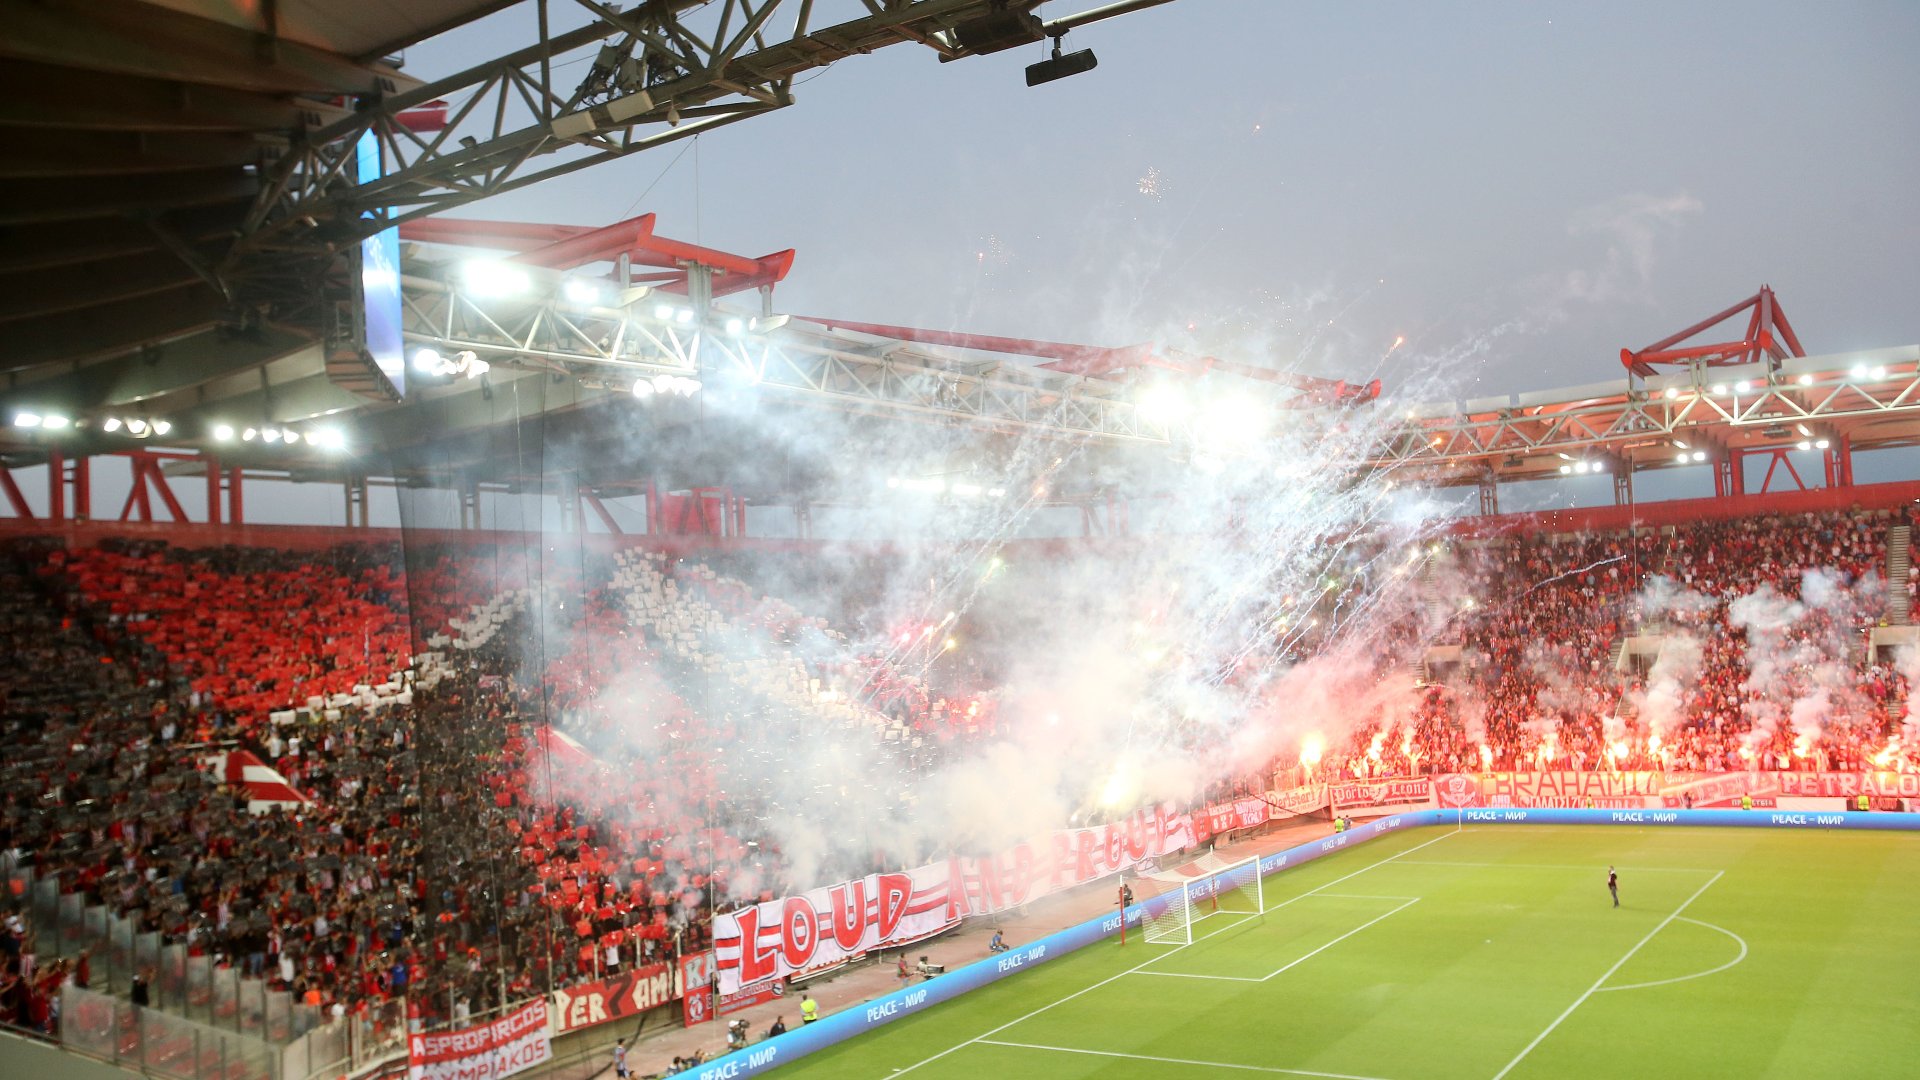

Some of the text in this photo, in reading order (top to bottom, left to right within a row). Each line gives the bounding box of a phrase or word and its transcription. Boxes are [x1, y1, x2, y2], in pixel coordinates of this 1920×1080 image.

[1334, 780, 1428, 802] Porto Leone
[1781, 772, 1919, 797] PETRALO
[1467, 811, 1527, 821] PEACE МИР
[1613, 811, 1677, 823] PEACE МИР
[1772, 814, 1844, 825] PEACE МИР
[733, 803, 1168, 988] LOUD AND PROUD
[998, 945, 1046, 973] PEACE МИР
[867, 989, 927, 1023] PEACE МИР
[419, 1039, 545, 1080] MPIAKOS
[748, 1046, 777, 1070] МИР
